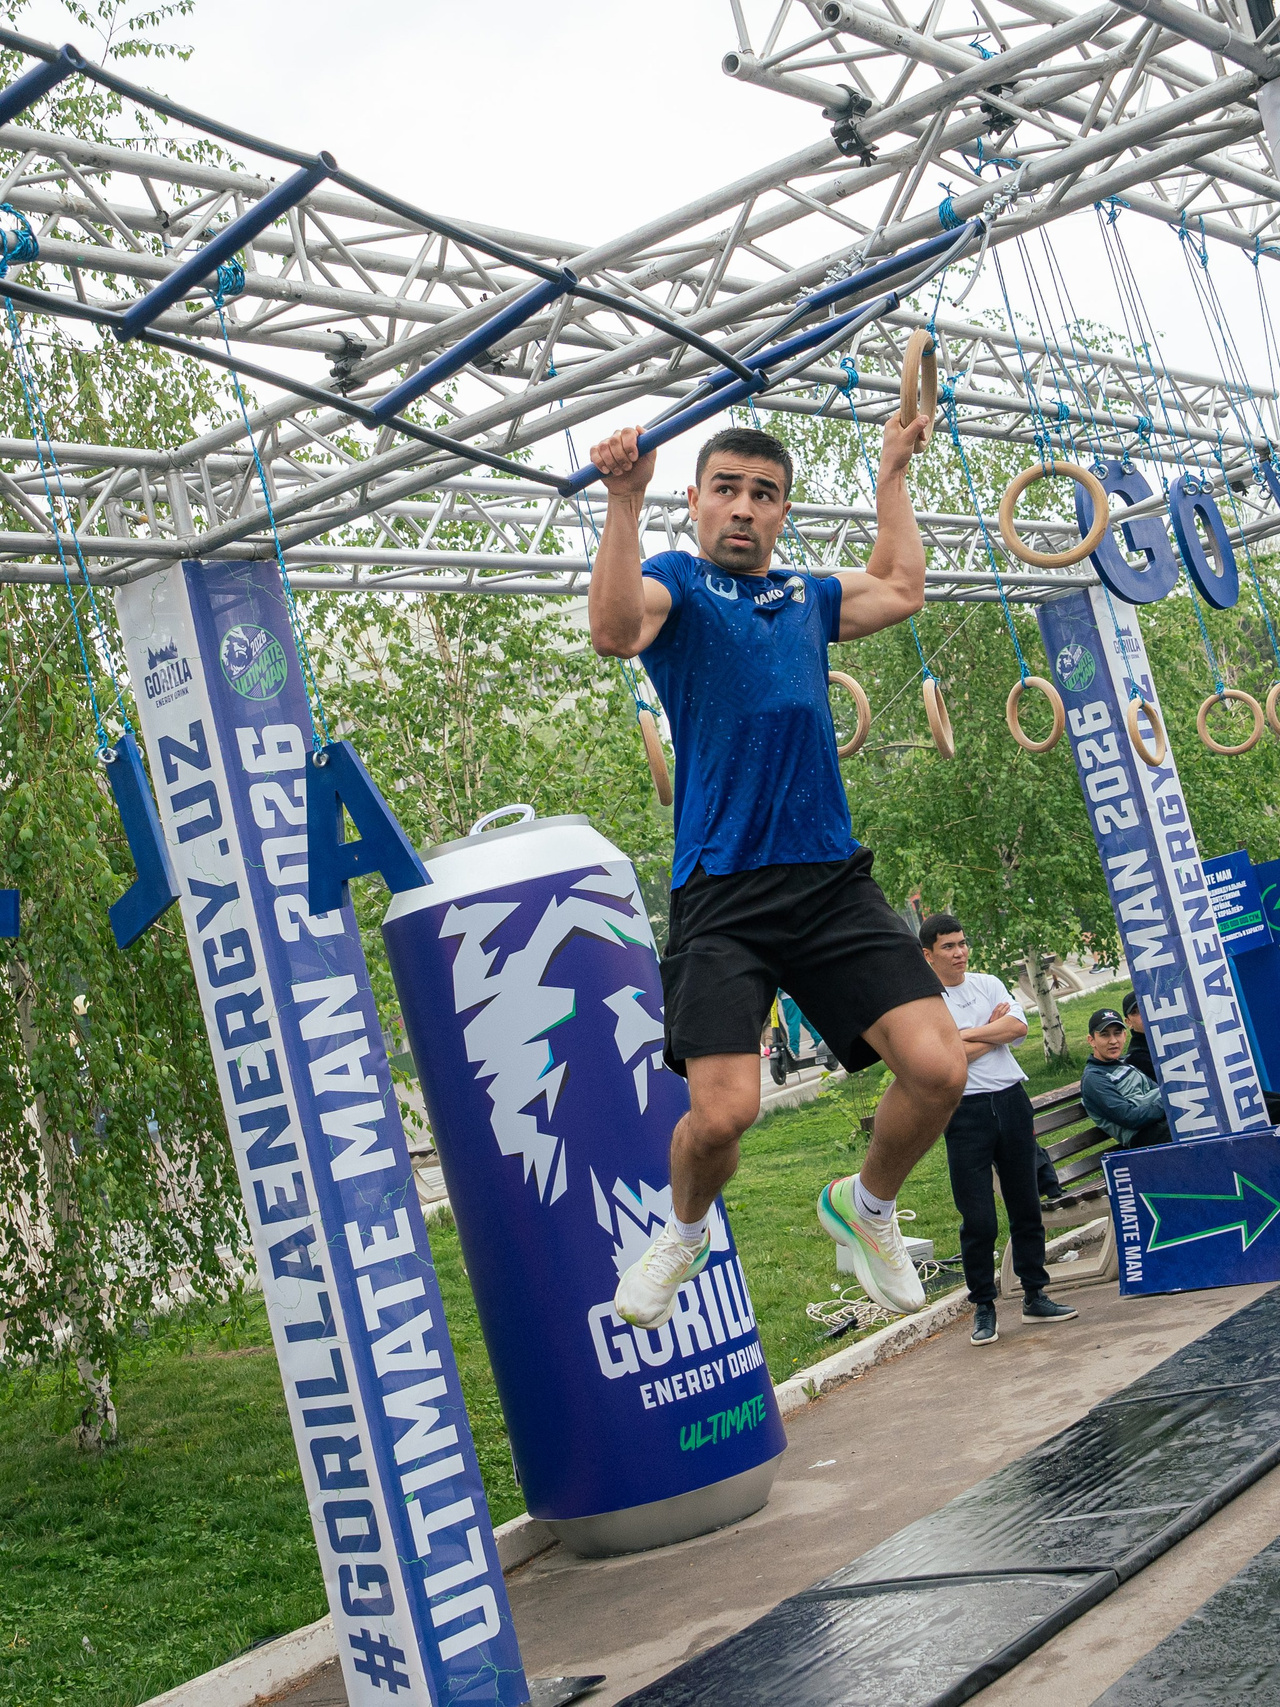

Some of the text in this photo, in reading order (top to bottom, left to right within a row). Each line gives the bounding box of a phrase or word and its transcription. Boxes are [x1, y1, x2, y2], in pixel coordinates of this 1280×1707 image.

[144, 657, 193, 699] GORILLA
[155, 687, 189, 708] ENERGY DRINK
[250, 629, 267, 657] 2026
[1113, 637, 1141, 654] GRILLA
[1068, 700, 1140, 835] 2026
[1107, 848, 1175, 971] MAN
[1142, 987, 1220, 1141] MATE
[158, 719, 411, 1694] #GORILLAENERGY.UZ
[239, 723, 501, 1661] ULTIMATE MAN 2026
[1113, 1167, 1143, 1282] ULTIMATE MAN
[587, 1255, 756, 1380] GORILL
[640, 1340, 765, 1410] ENERGY DRINK
[680, 1393, 767, 1450] ULTIMATE
